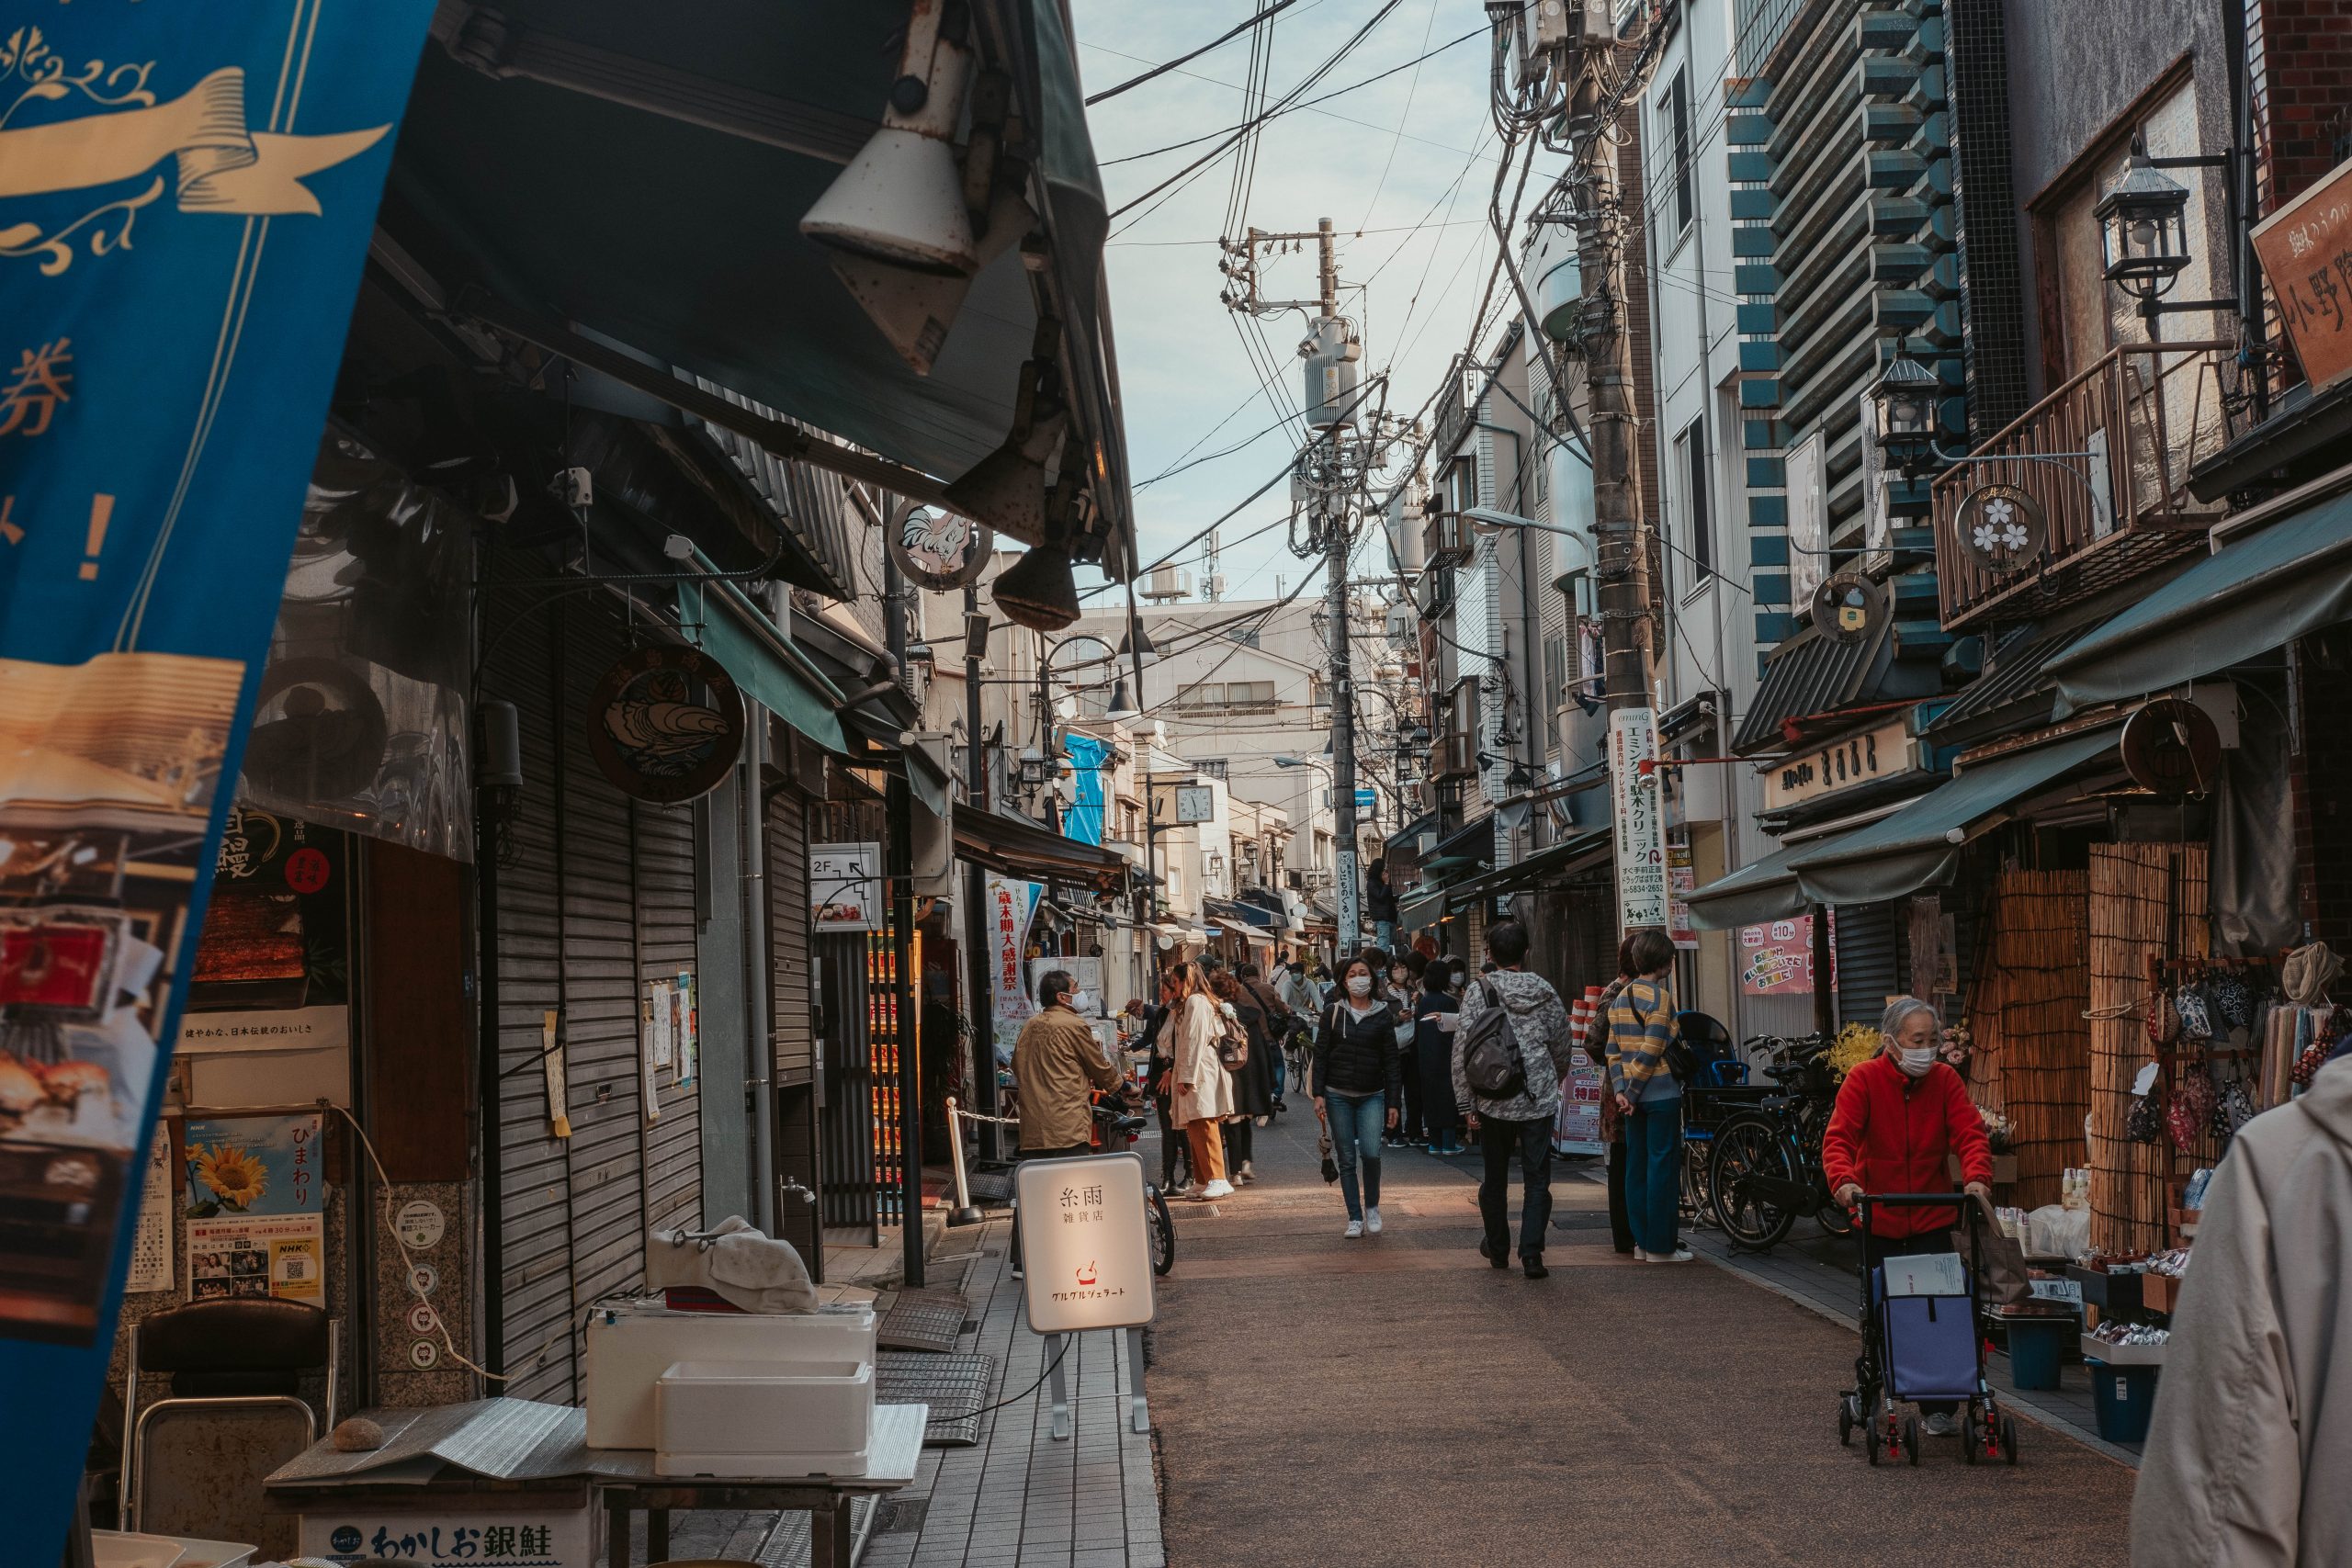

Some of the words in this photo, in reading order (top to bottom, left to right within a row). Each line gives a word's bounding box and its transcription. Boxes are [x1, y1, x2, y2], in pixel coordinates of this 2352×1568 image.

[814, 861, 831, 872] 2F
[999, 890, 1017, 991] 歳末期大感謝祭
[186, 1024, 312, 1038] 健やかな、日本伝統のおいしさ
[291, 1128, 311, 1206] ひまわり
[1059, 1184, 1103, 1208] 糸雨
[1063, 1210, 1103, 1224] 雑貨店
[370, 1524, 551, 1559] わかしお銀鮭
